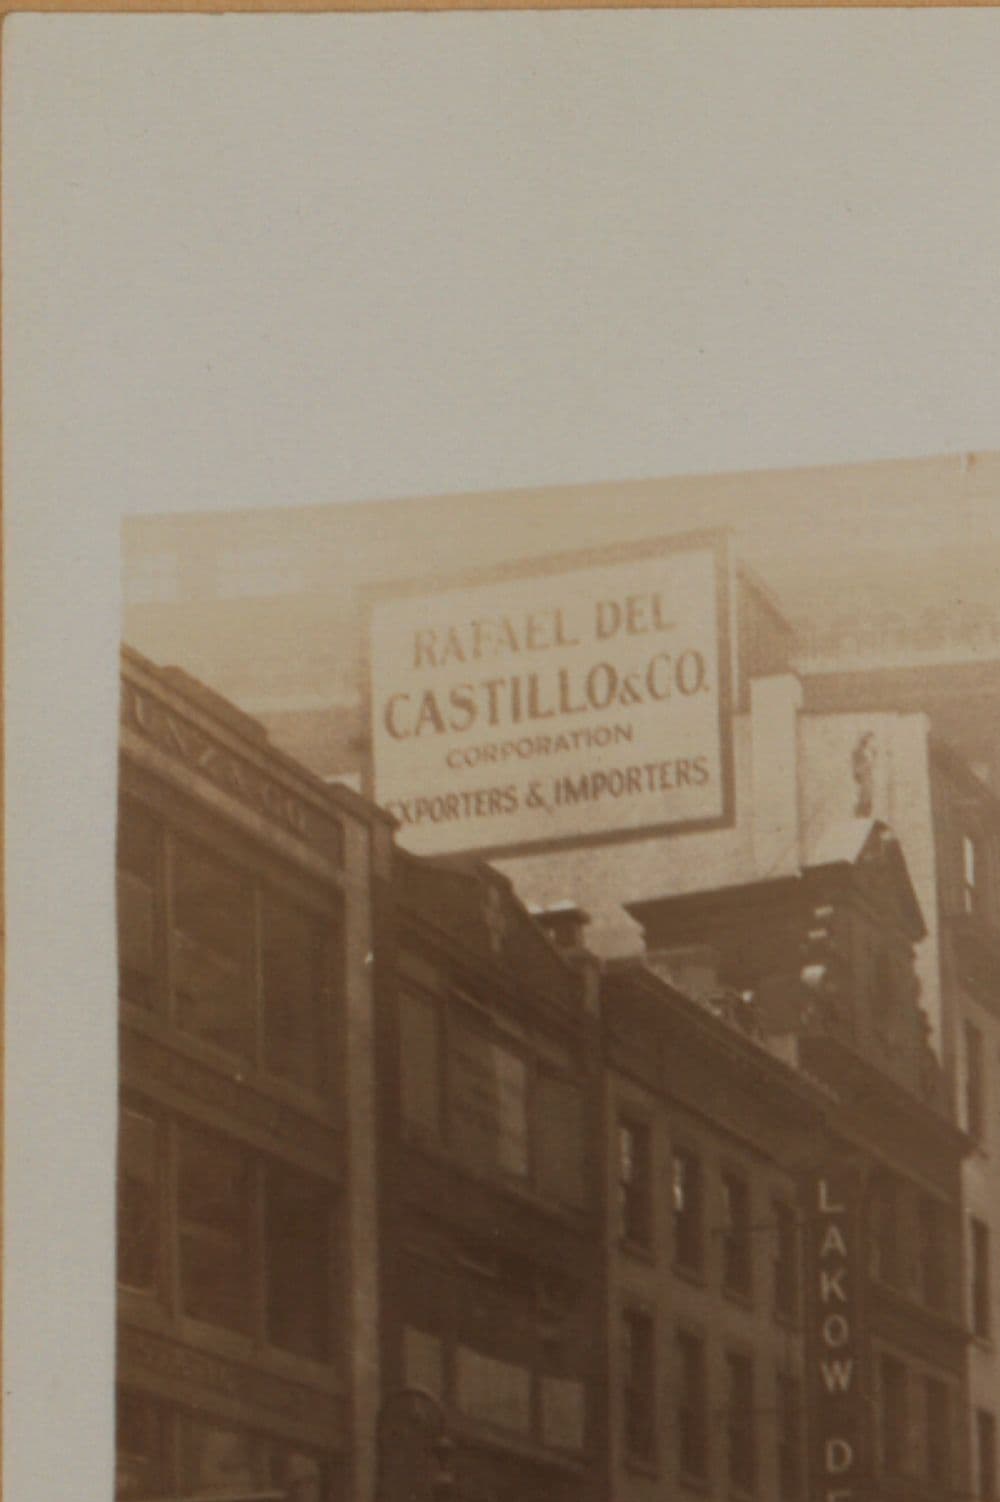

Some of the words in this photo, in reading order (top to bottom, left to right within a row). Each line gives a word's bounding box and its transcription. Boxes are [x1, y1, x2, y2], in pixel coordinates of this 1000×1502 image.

[412, 606, 580, 670] RAFAEL
[595, 593, 678, 641] DEL
[445, 722, 634, 769] CORPORATION
[525, 779, 552, 813] &
[553, 755, 710, 806] IMPORTERS
[816, 1179, 854, 1394] LAKOW
